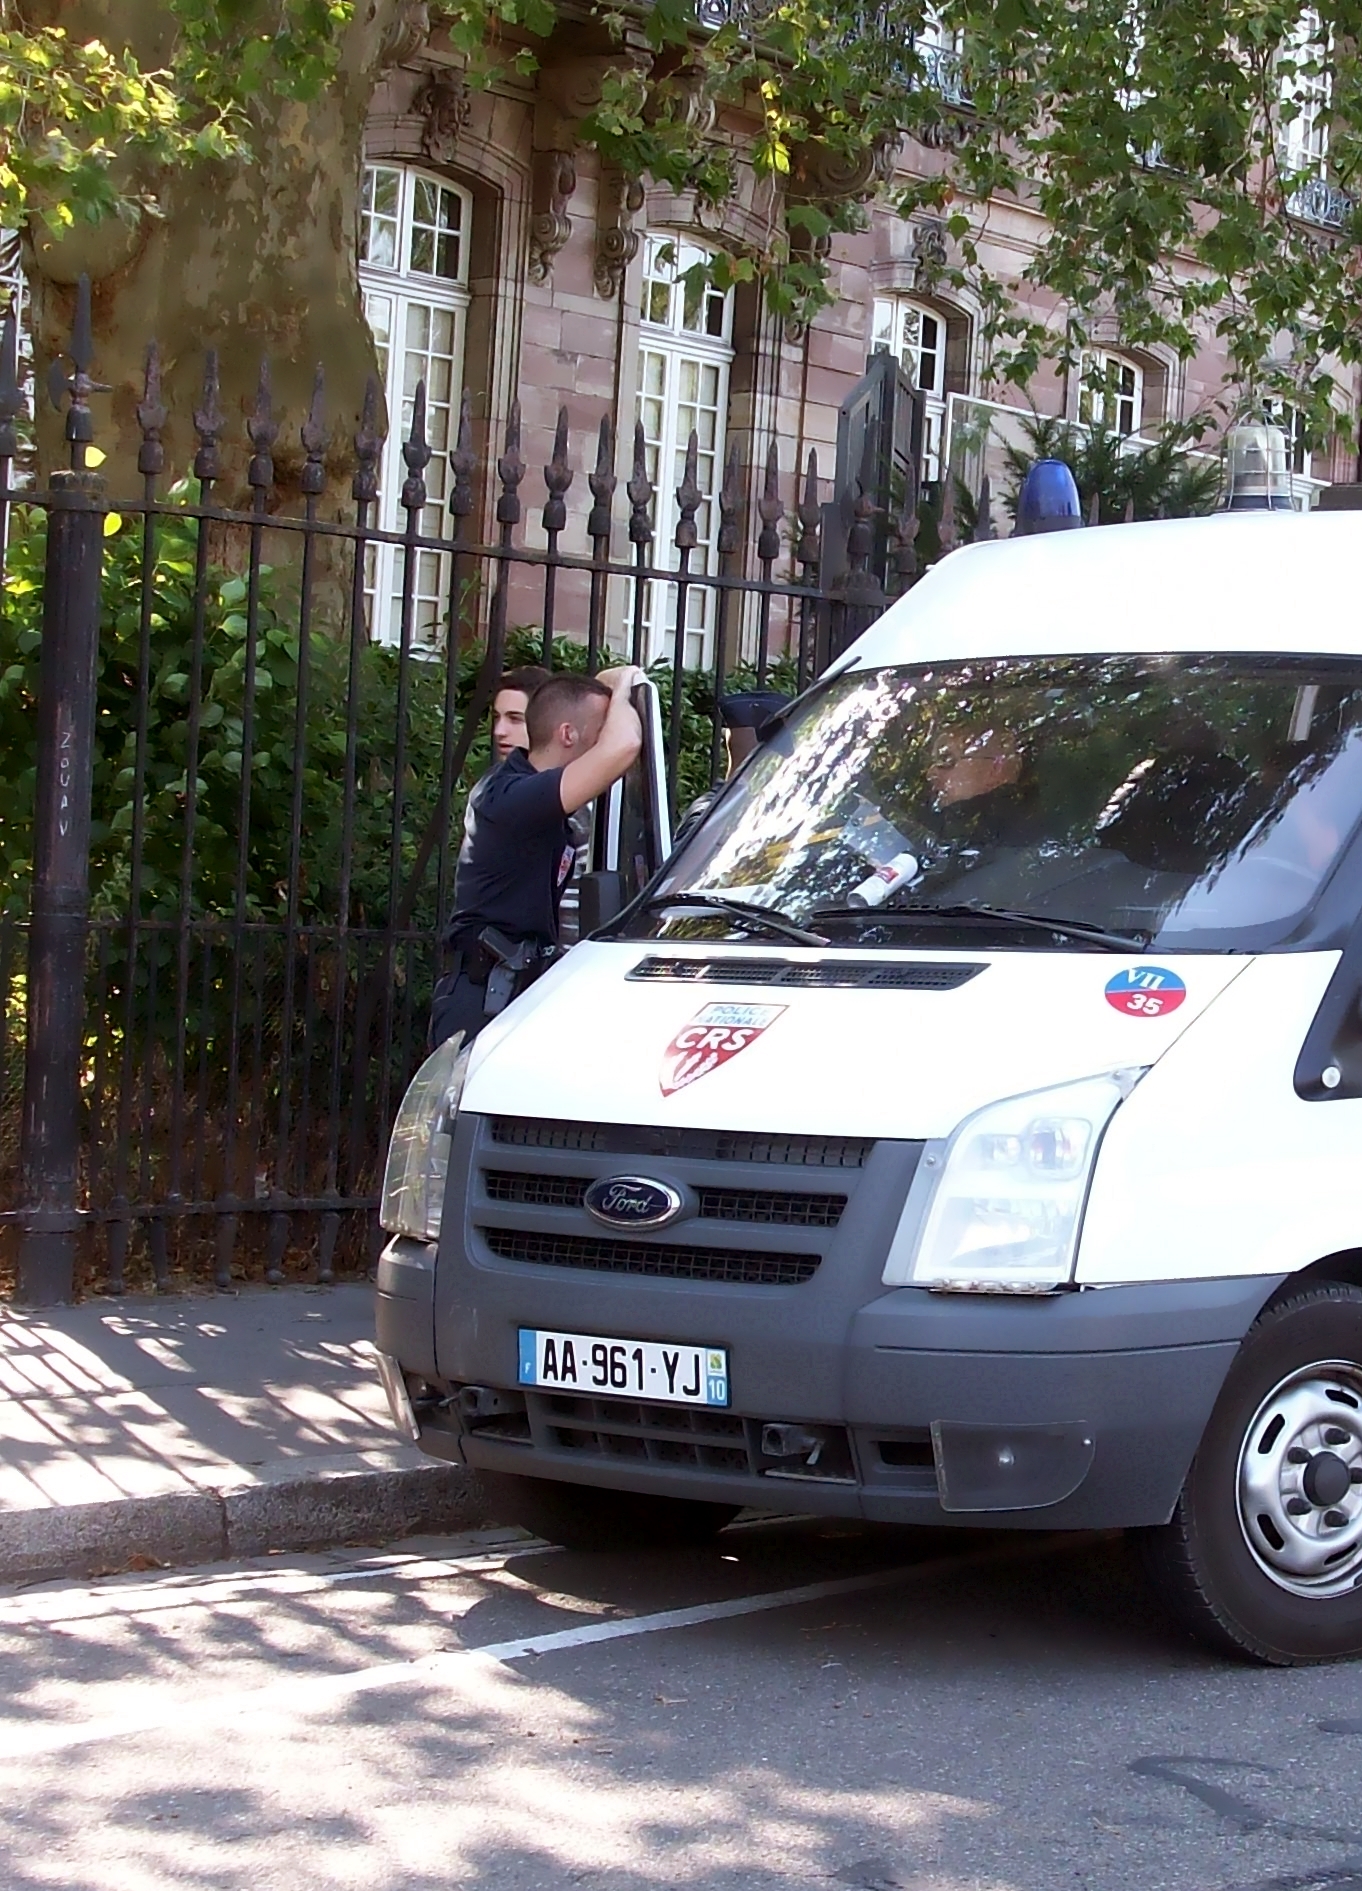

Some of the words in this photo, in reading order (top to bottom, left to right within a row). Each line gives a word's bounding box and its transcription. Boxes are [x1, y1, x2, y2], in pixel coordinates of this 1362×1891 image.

[1127, 968, 1166, 991] VII
[710, 1005, 773, 1016] POLICE
[1126, 993, 1164, 1015] 35
[696, 1015, 767, 1026] ATIONALE
[675, 1027, 755, 1051] CRS
[602, 1184, 654, 1213] Ford
[708, 1379, 726, 1401] 10
